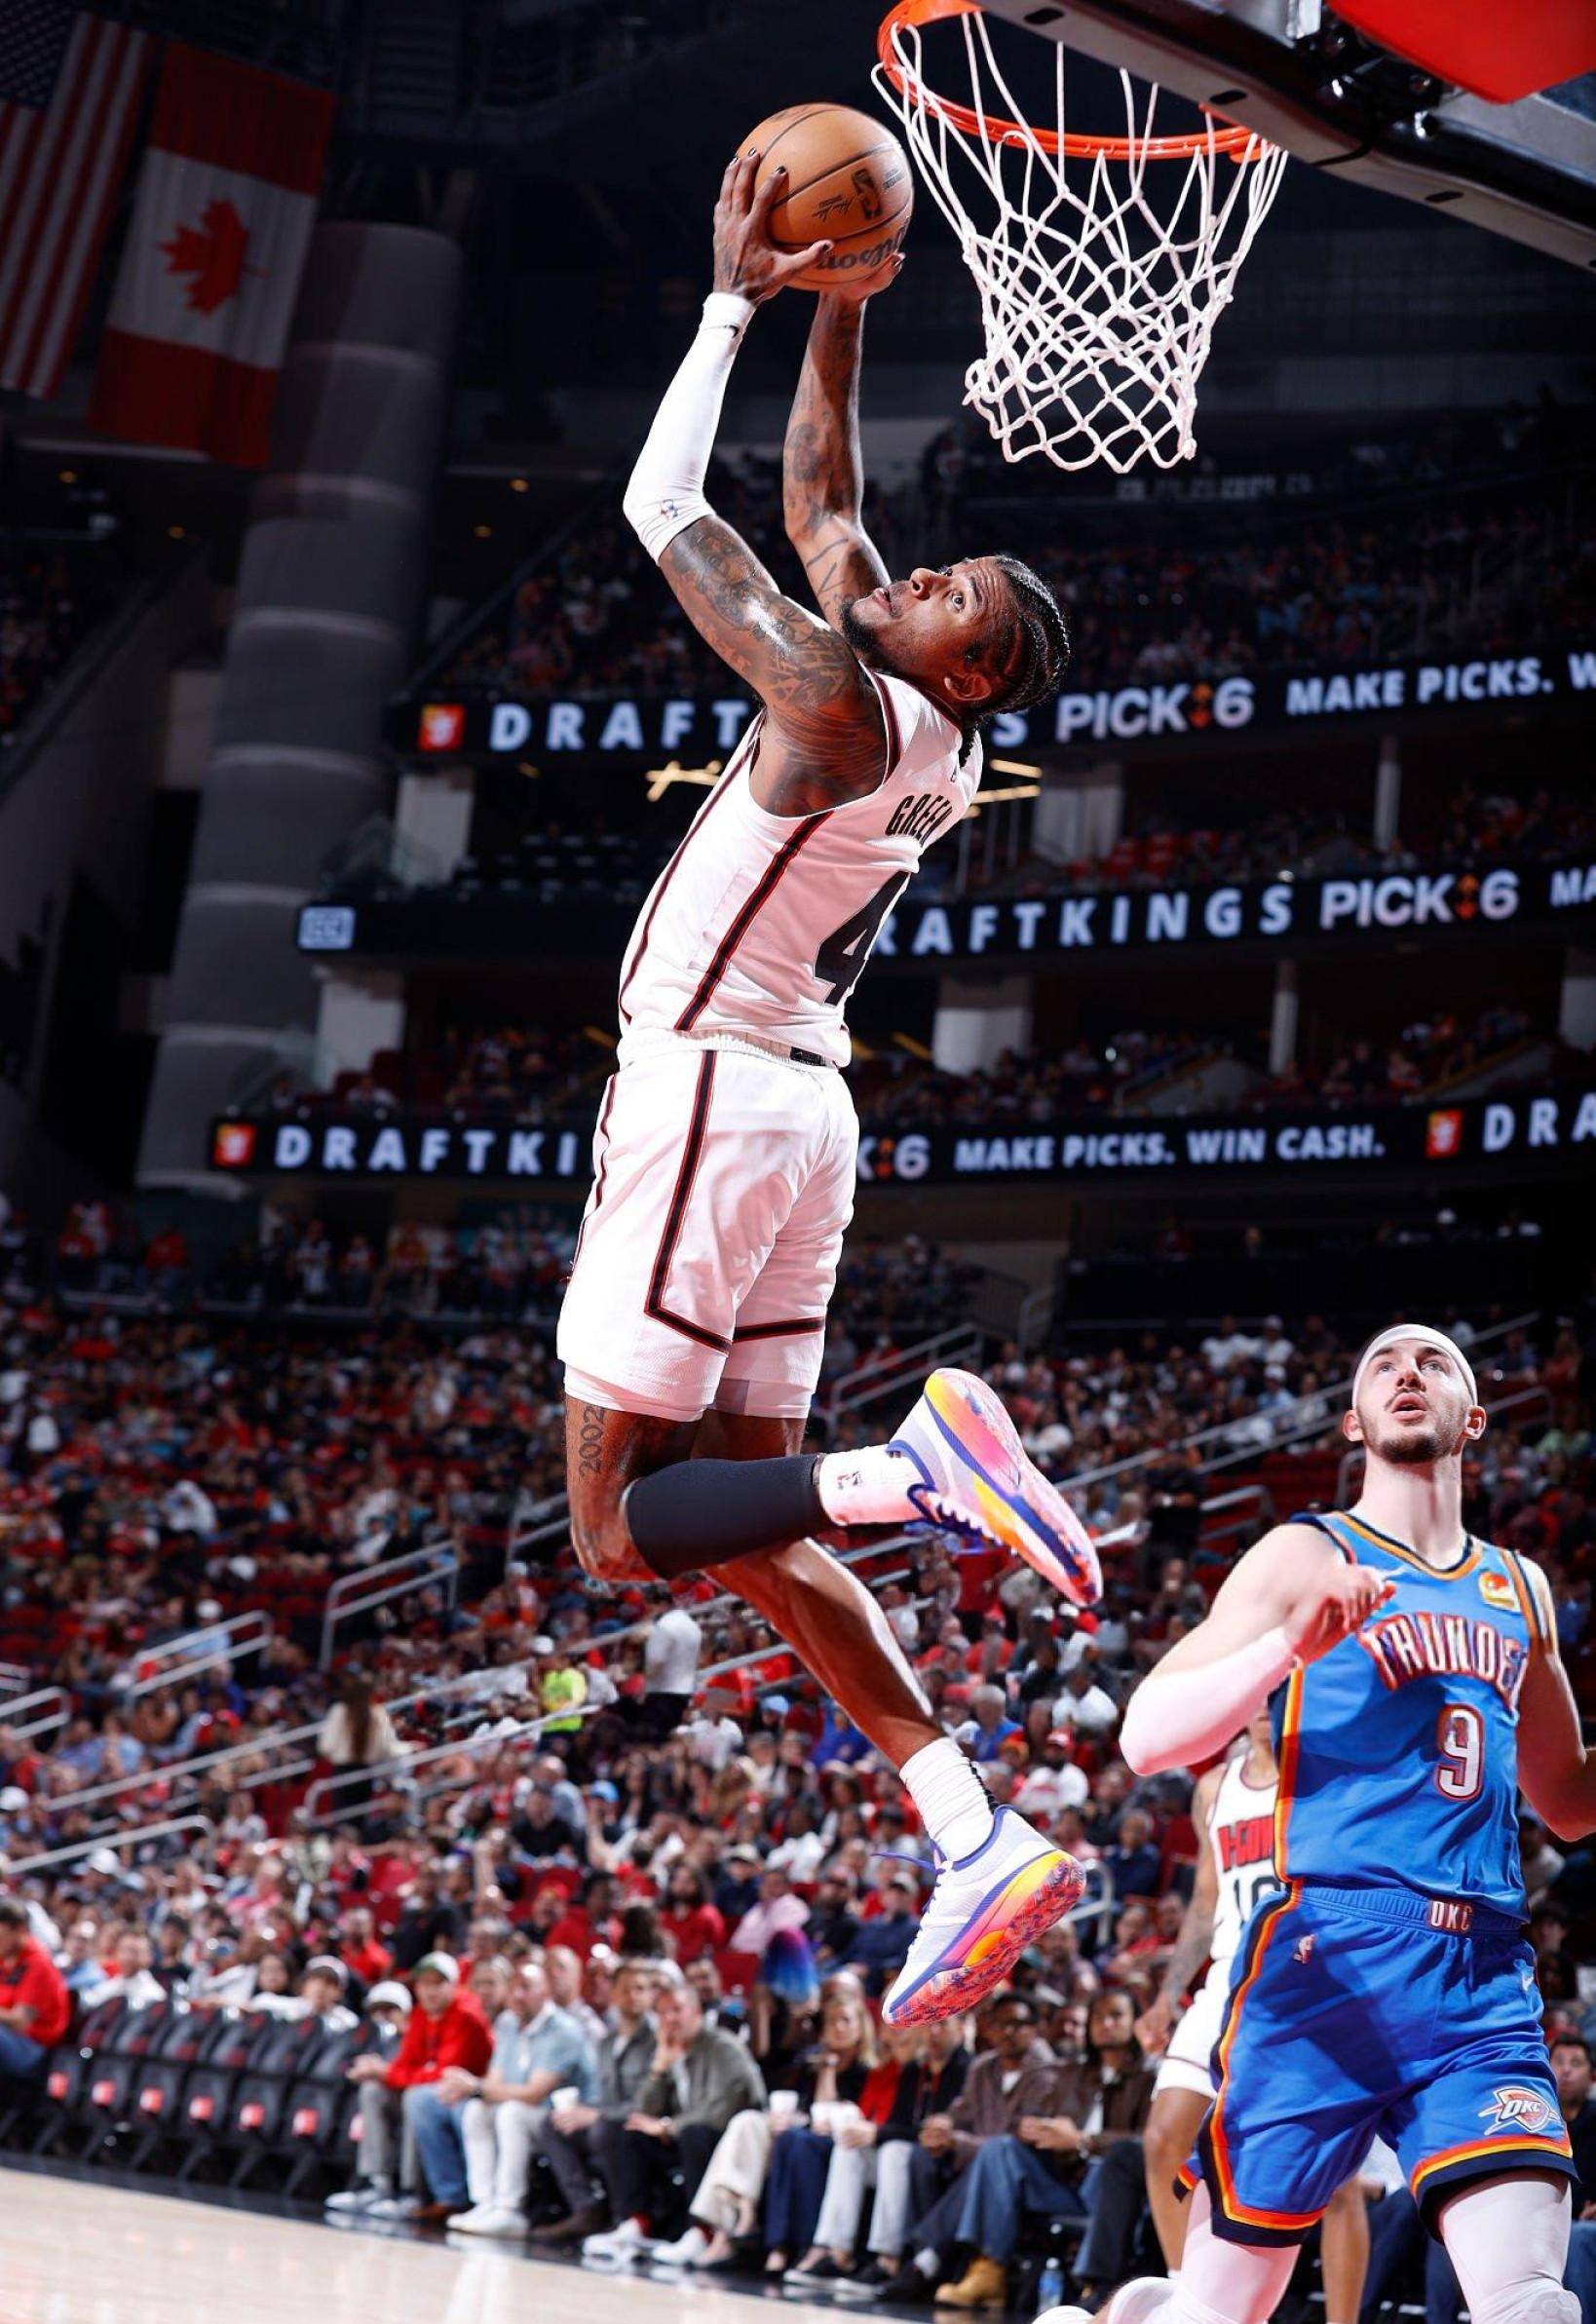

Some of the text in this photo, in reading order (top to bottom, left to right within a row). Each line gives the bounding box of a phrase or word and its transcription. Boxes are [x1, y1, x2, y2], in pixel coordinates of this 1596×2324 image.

[1287, 669, 1405, 714] MAKE
[1417, 657, 1554, 704] PICKS.
[815, 870, 910, 1007] 4
[275, 1125, 578, 1175] DRAFTKI
[955, 1135, 1054, 1170] MAKE
[1062, 1132, 1175, 1168] PICKS.
[1188, 1128, 1266, 1163] WIN
[1277, 1124, 1385, 1161] CASH.
[1483, 1091, 1596, 1153] DRA
[579, 1405, 604, 1477] 2002
[1436, 1703, 1485, 1801] 9
[1430, 1900, 1473, 1931] OKC
[1501, 2099, 1542, 2120] OKC
